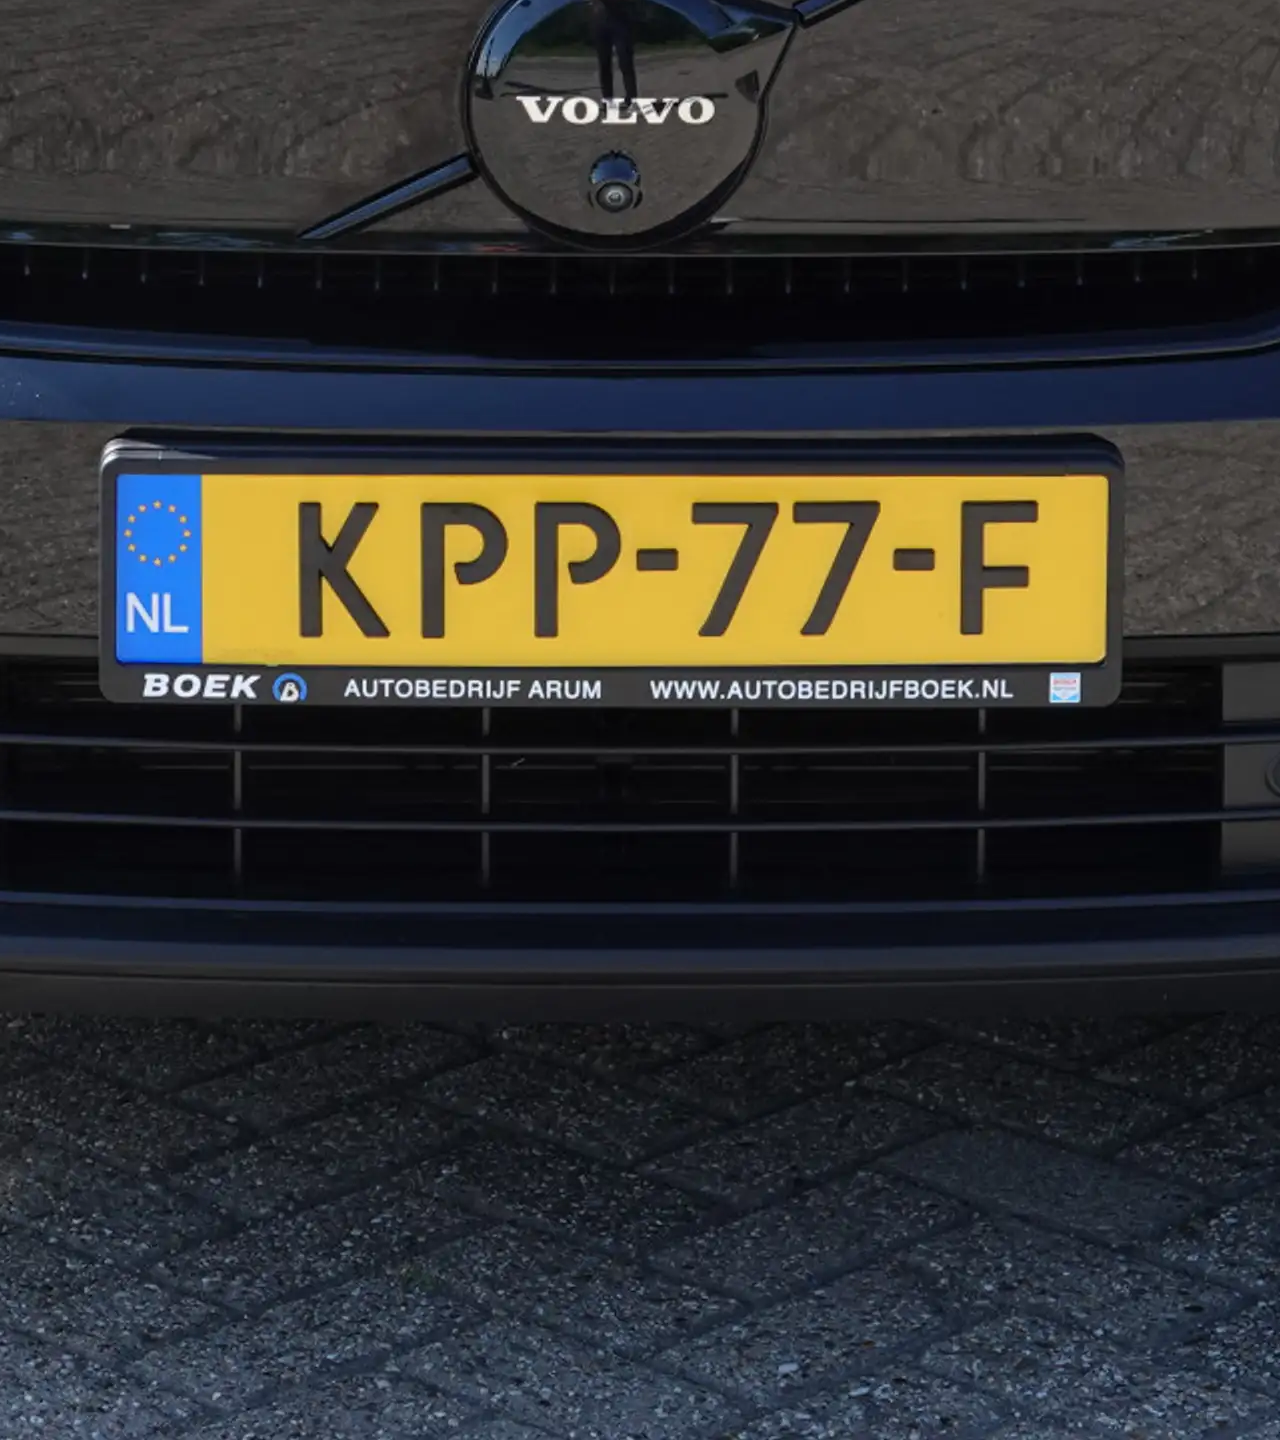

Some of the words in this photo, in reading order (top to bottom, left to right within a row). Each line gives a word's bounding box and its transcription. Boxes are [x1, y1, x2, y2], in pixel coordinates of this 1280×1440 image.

[516, 95, 716, 126] VOLVO
[297, 500, 1040, 639] KPP-77-F
[125, 592, 190, 634] NL
[142, 673, 262, 699] BOEK
[343, 678, 522, 699] AUTOBEDRIJF
[527, 679, 603, 700] ARUM
[649, 678, 1014, 701] WWW.AUTOBEDRIJFBOEK.NL
